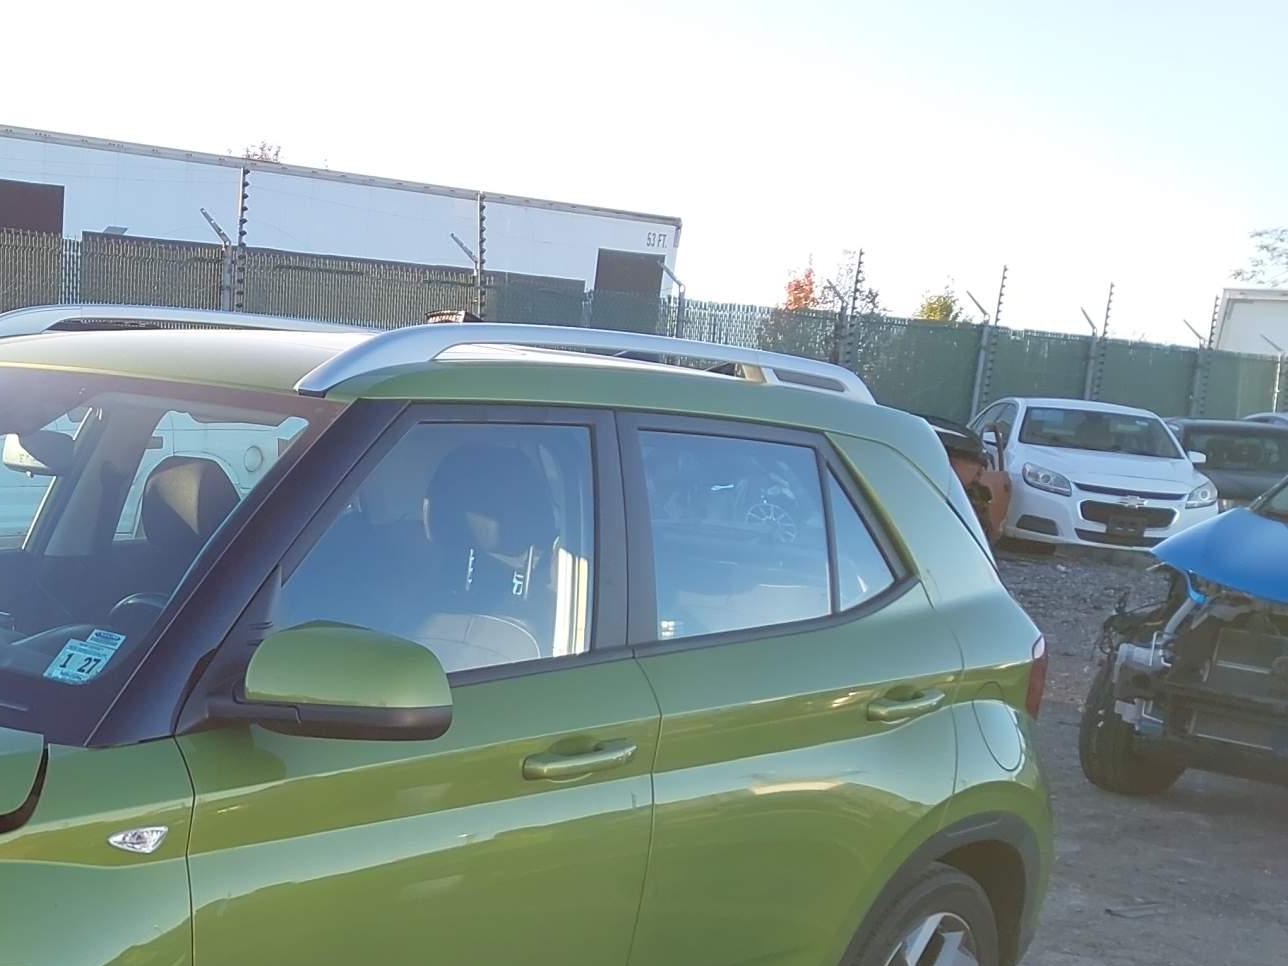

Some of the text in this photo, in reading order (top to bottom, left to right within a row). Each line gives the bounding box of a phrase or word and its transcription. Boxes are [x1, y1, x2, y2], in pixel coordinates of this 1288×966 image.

[646, 232, 657, 247] 53
[59, 653, 102, 674] 1 27
